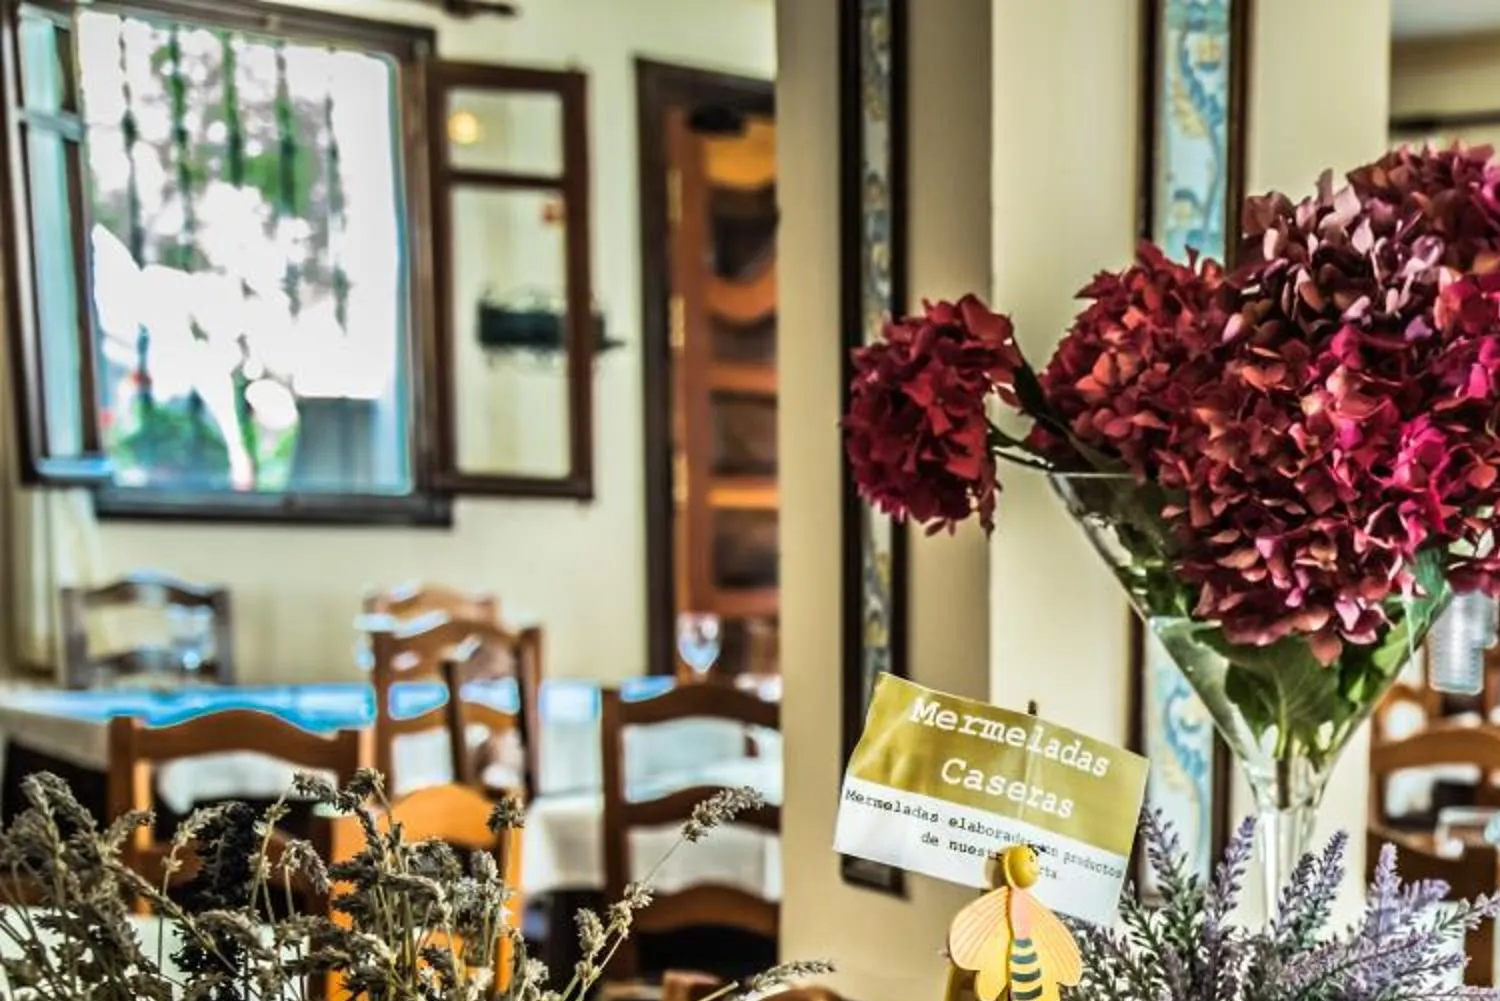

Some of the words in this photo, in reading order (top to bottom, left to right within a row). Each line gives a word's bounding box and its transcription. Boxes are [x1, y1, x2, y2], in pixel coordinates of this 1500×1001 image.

[909, 697, 1111, 778] Mermeladas
[940, 757, 1075, 819] Caseras
[845, 788, 939, 824] Mermeladas
[1063, 850, 1123, 879] productos
[920, 831, 939, 847] de
